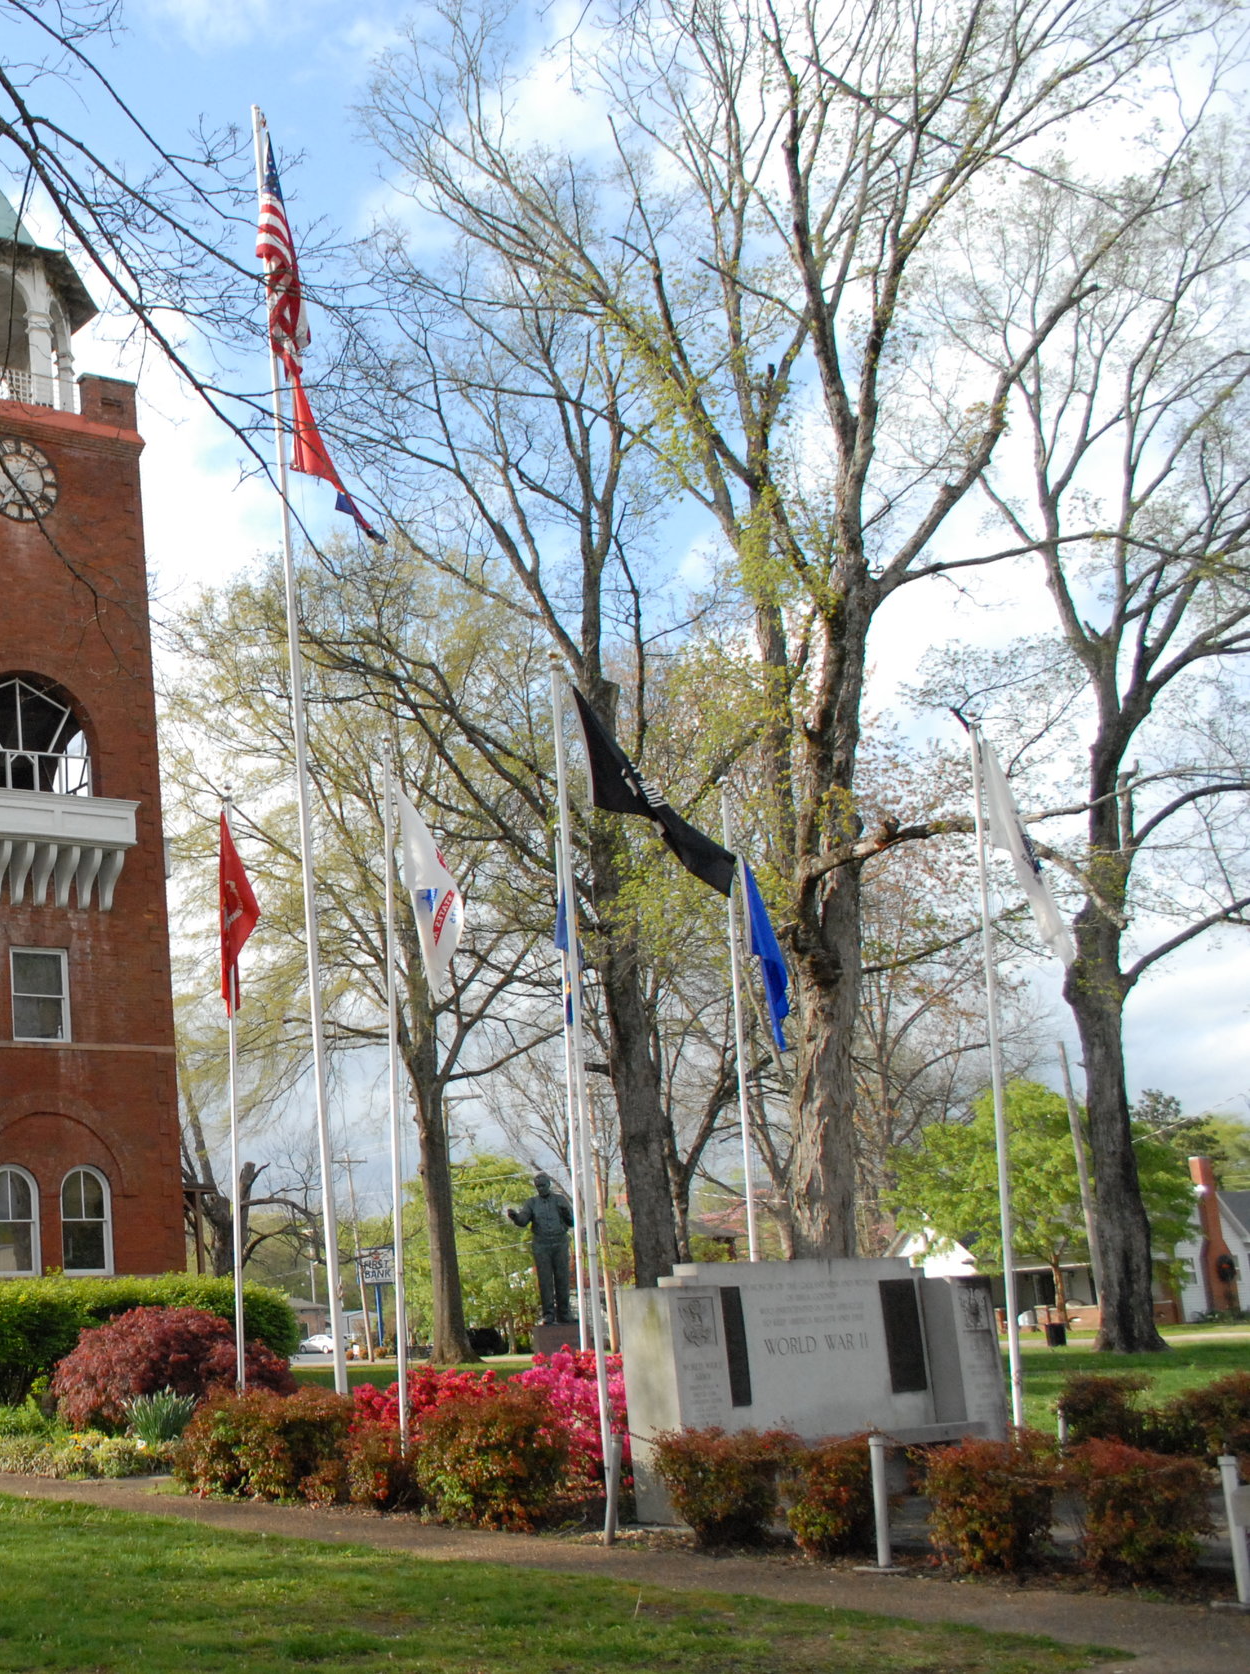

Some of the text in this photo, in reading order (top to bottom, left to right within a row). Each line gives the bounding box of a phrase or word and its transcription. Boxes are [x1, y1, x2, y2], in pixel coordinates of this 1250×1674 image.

[364, 1260, 389, 1269] FIRST
[365, 1269, 390, 1278] BANK
[764, 1331, 869, 1356] WORLD WAR II
